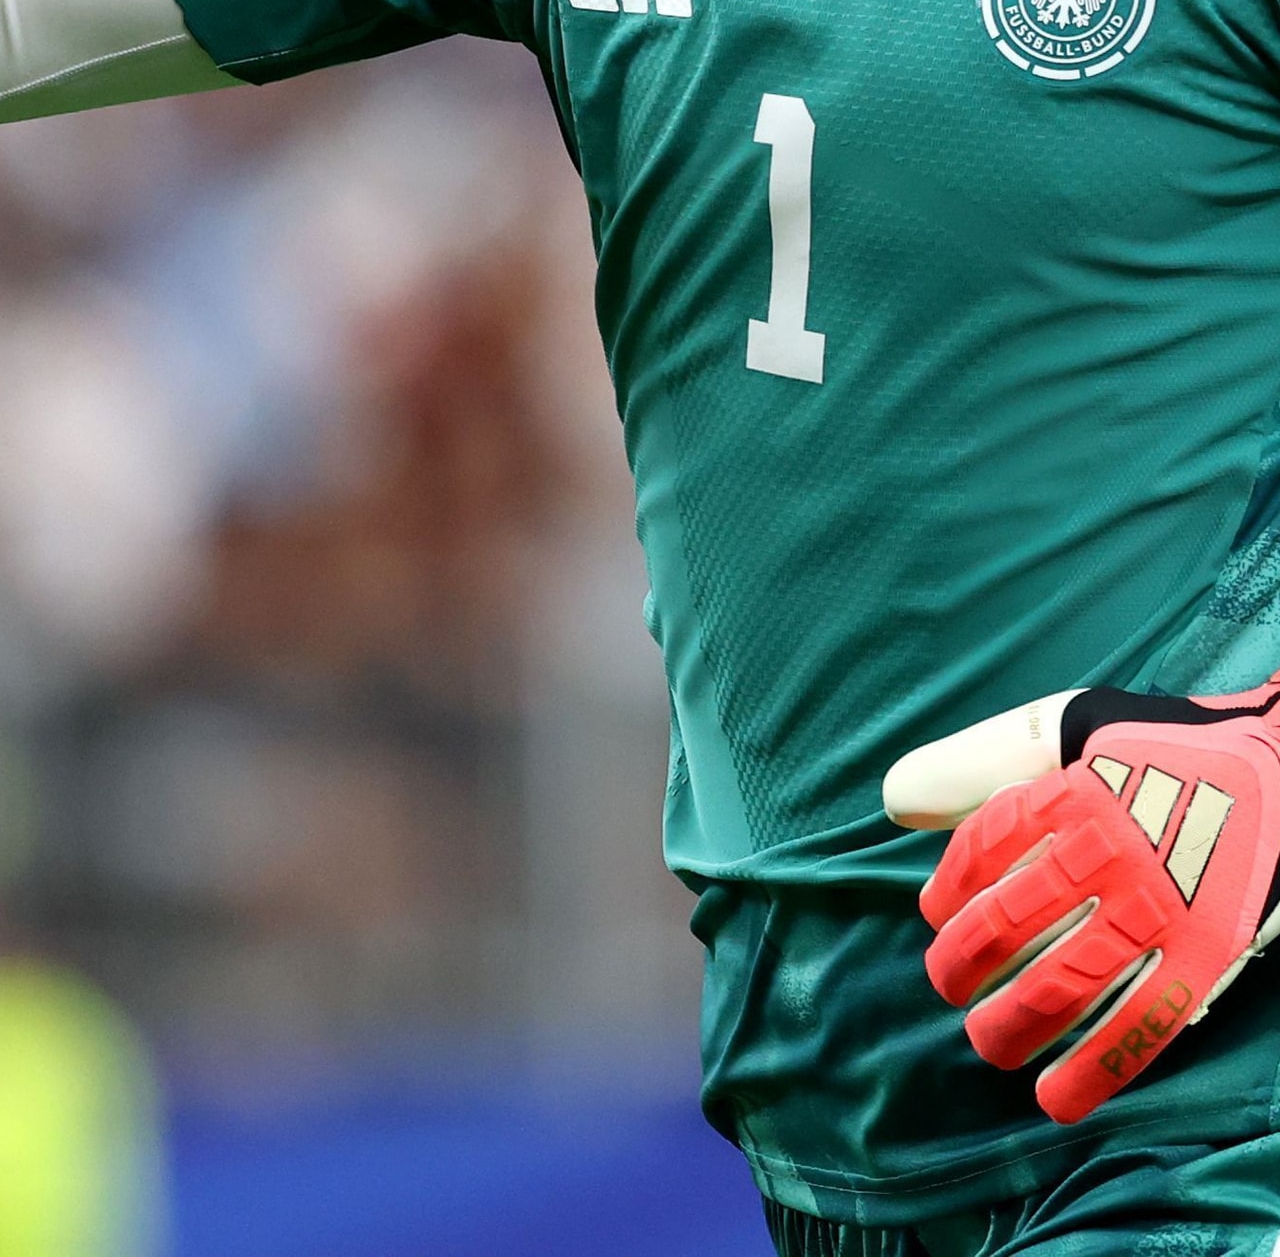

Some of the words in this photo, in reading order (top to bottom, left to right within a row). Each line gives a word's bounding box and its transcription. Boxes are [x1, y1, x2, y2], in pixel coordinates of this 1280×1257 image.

[1005, 4, 1124, 56] FUSSBALL-BUND
[745, 92, 826, 384] 1
[1099, 980, 1193, 1079] PRED
